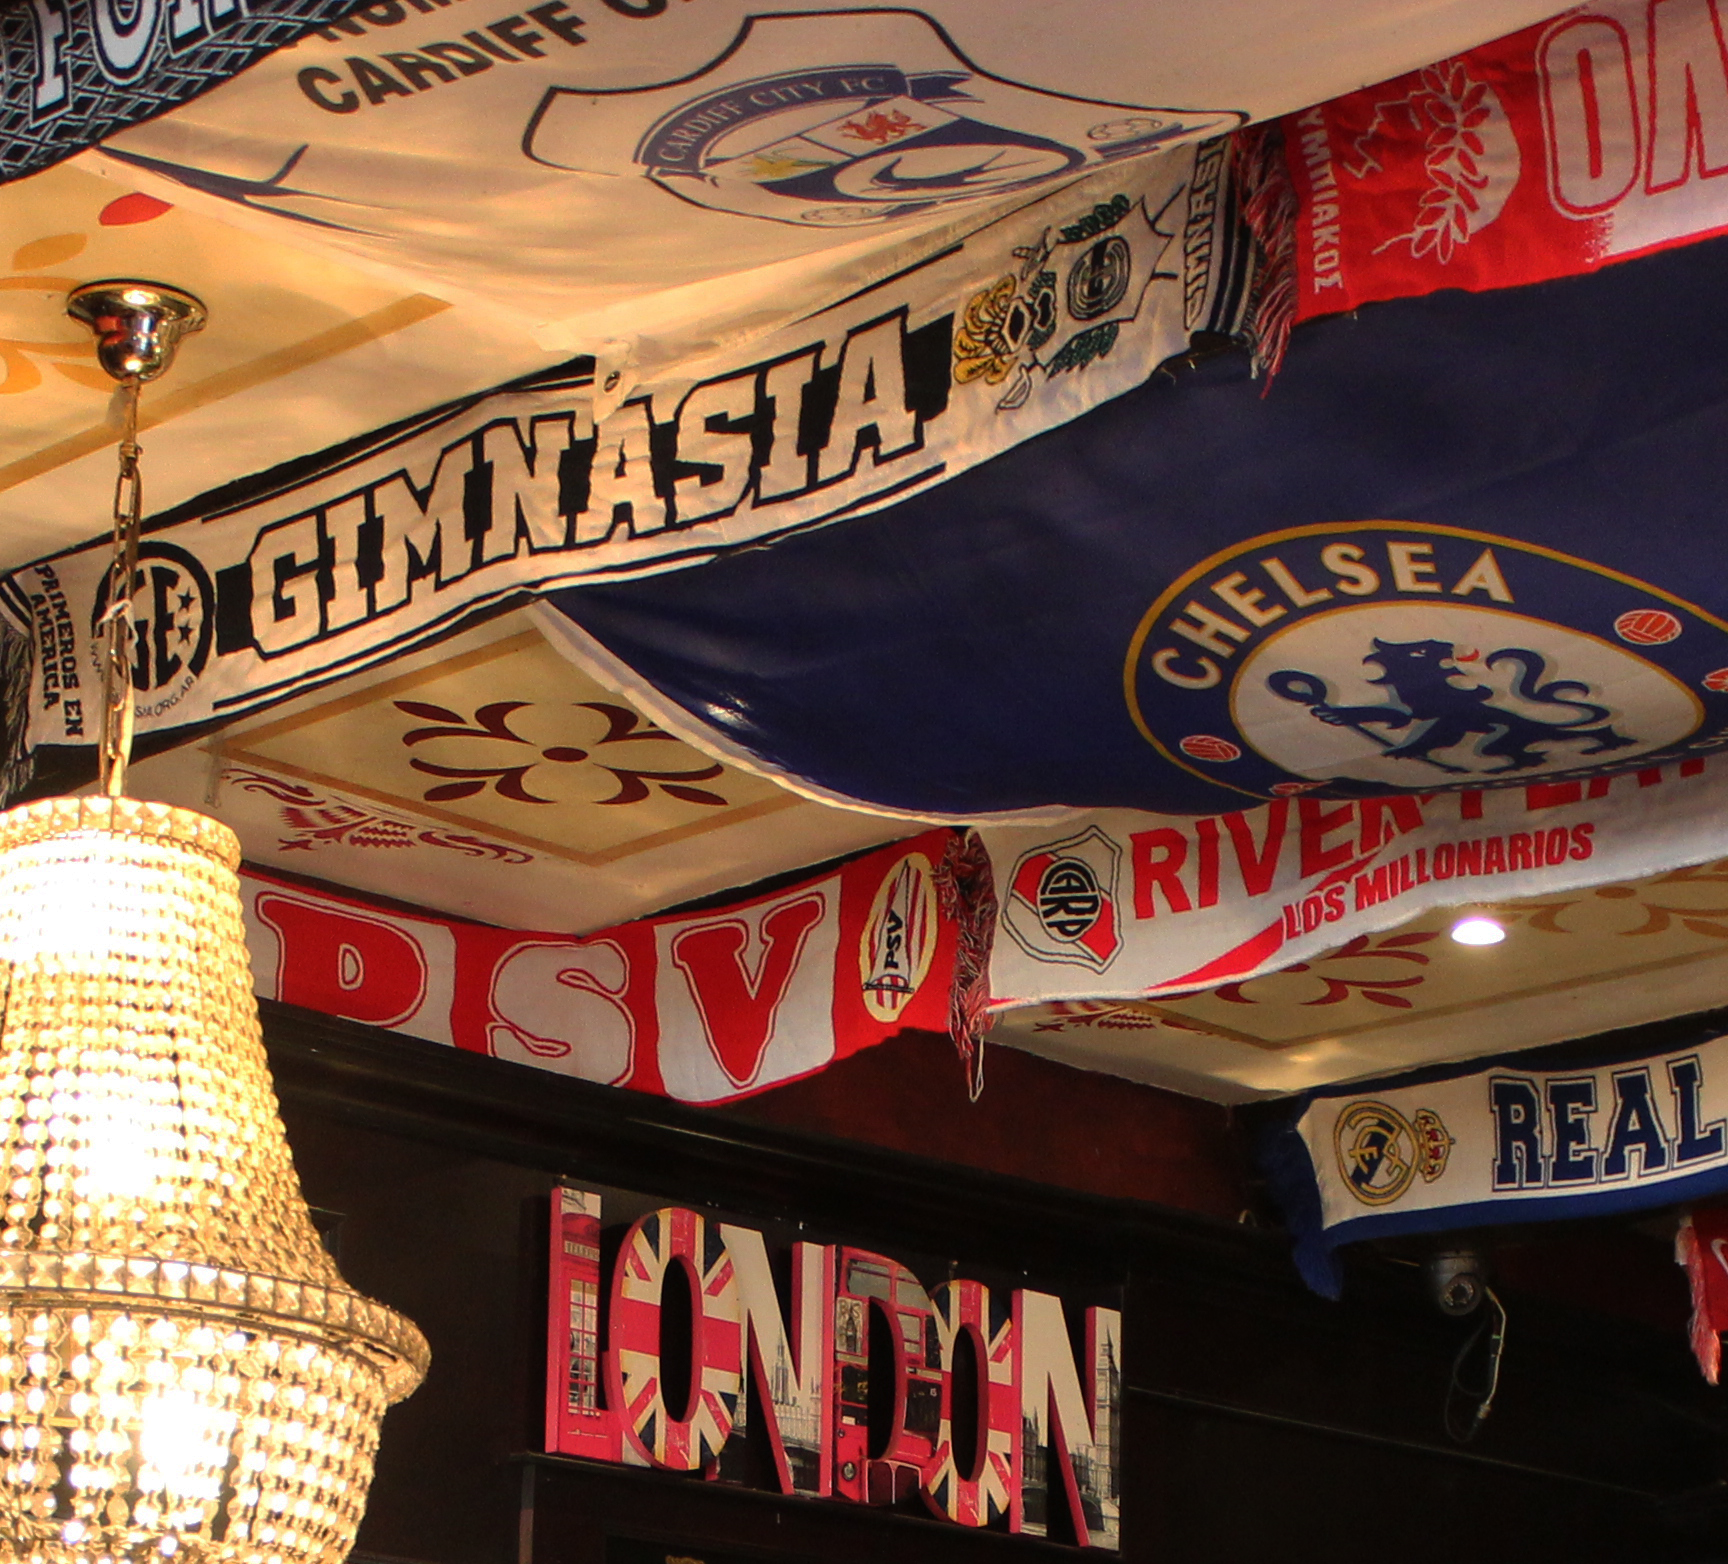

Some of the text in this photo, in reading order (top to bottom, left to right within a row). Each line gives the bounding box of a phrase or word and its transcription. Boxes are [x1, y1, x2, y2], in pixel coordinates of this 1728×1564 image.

[296, 0, 590, 114] CARDIFF
[657, 74, 889, 163] CARDIFF CITY FC
[1298, 106, 1344, 296] ΥΜΠΙΑΚΟΣ
[244, 305, 944, 663] GIMNASIA
[30, 593, 62, 710] AMERICA
[35, 565, 84, 737] PRIMEROS EN
[1150, 540, 1514, 691] CHELSEA
[883, 911, 904, 971] PSV
[1283, 823, 1595, 940] LOS MILLONARIOS
[255, 890, 827, 1090] PSV
[1489, 1056, 1728, 1194] REAL
[545, 1185, 1123, 1552] LONDON
